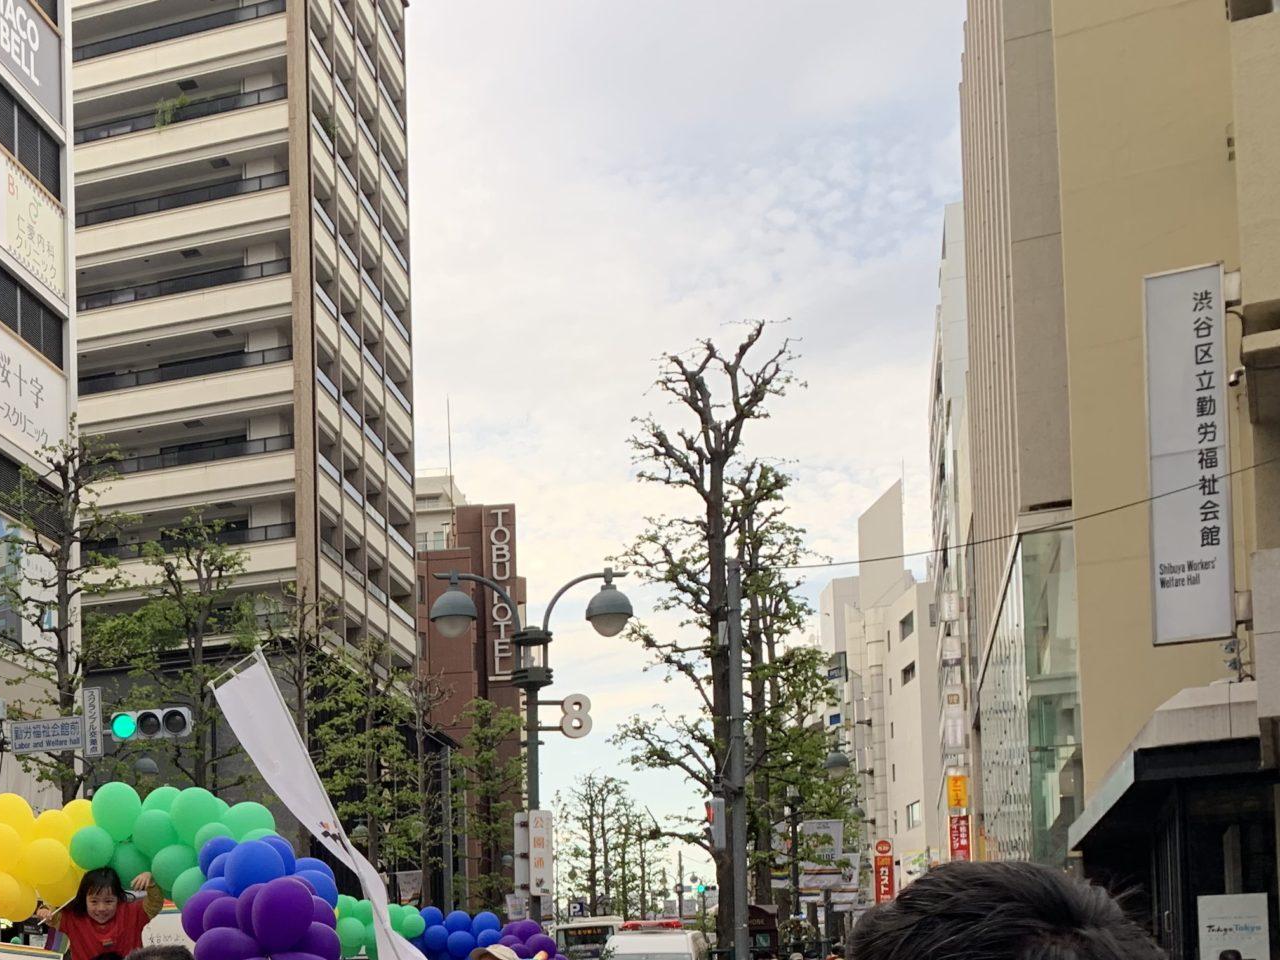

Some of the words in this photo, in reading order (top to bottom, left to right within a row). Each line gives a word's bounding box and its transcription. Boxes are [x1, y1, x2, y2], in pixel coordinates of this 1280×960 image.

[0, 17, 40, 87] BELL
[1191, 289, 1221, 549] 渋谷区立勤労福祉会館
[489, 508, 512, 581] TOBU
[1159, 563, 1186, 576] Shibuya
[1160, 577, 1185, 589] Welfare
[1186, 573, 1201, 586] Hall
[492, 585, 513, 676] HOTEL
[14, 742, 31, 750] Labor
[33, 740, 44, 748] and
[46, 737, 68, 747] Welfare
[560, 694, 593, 739] 8
